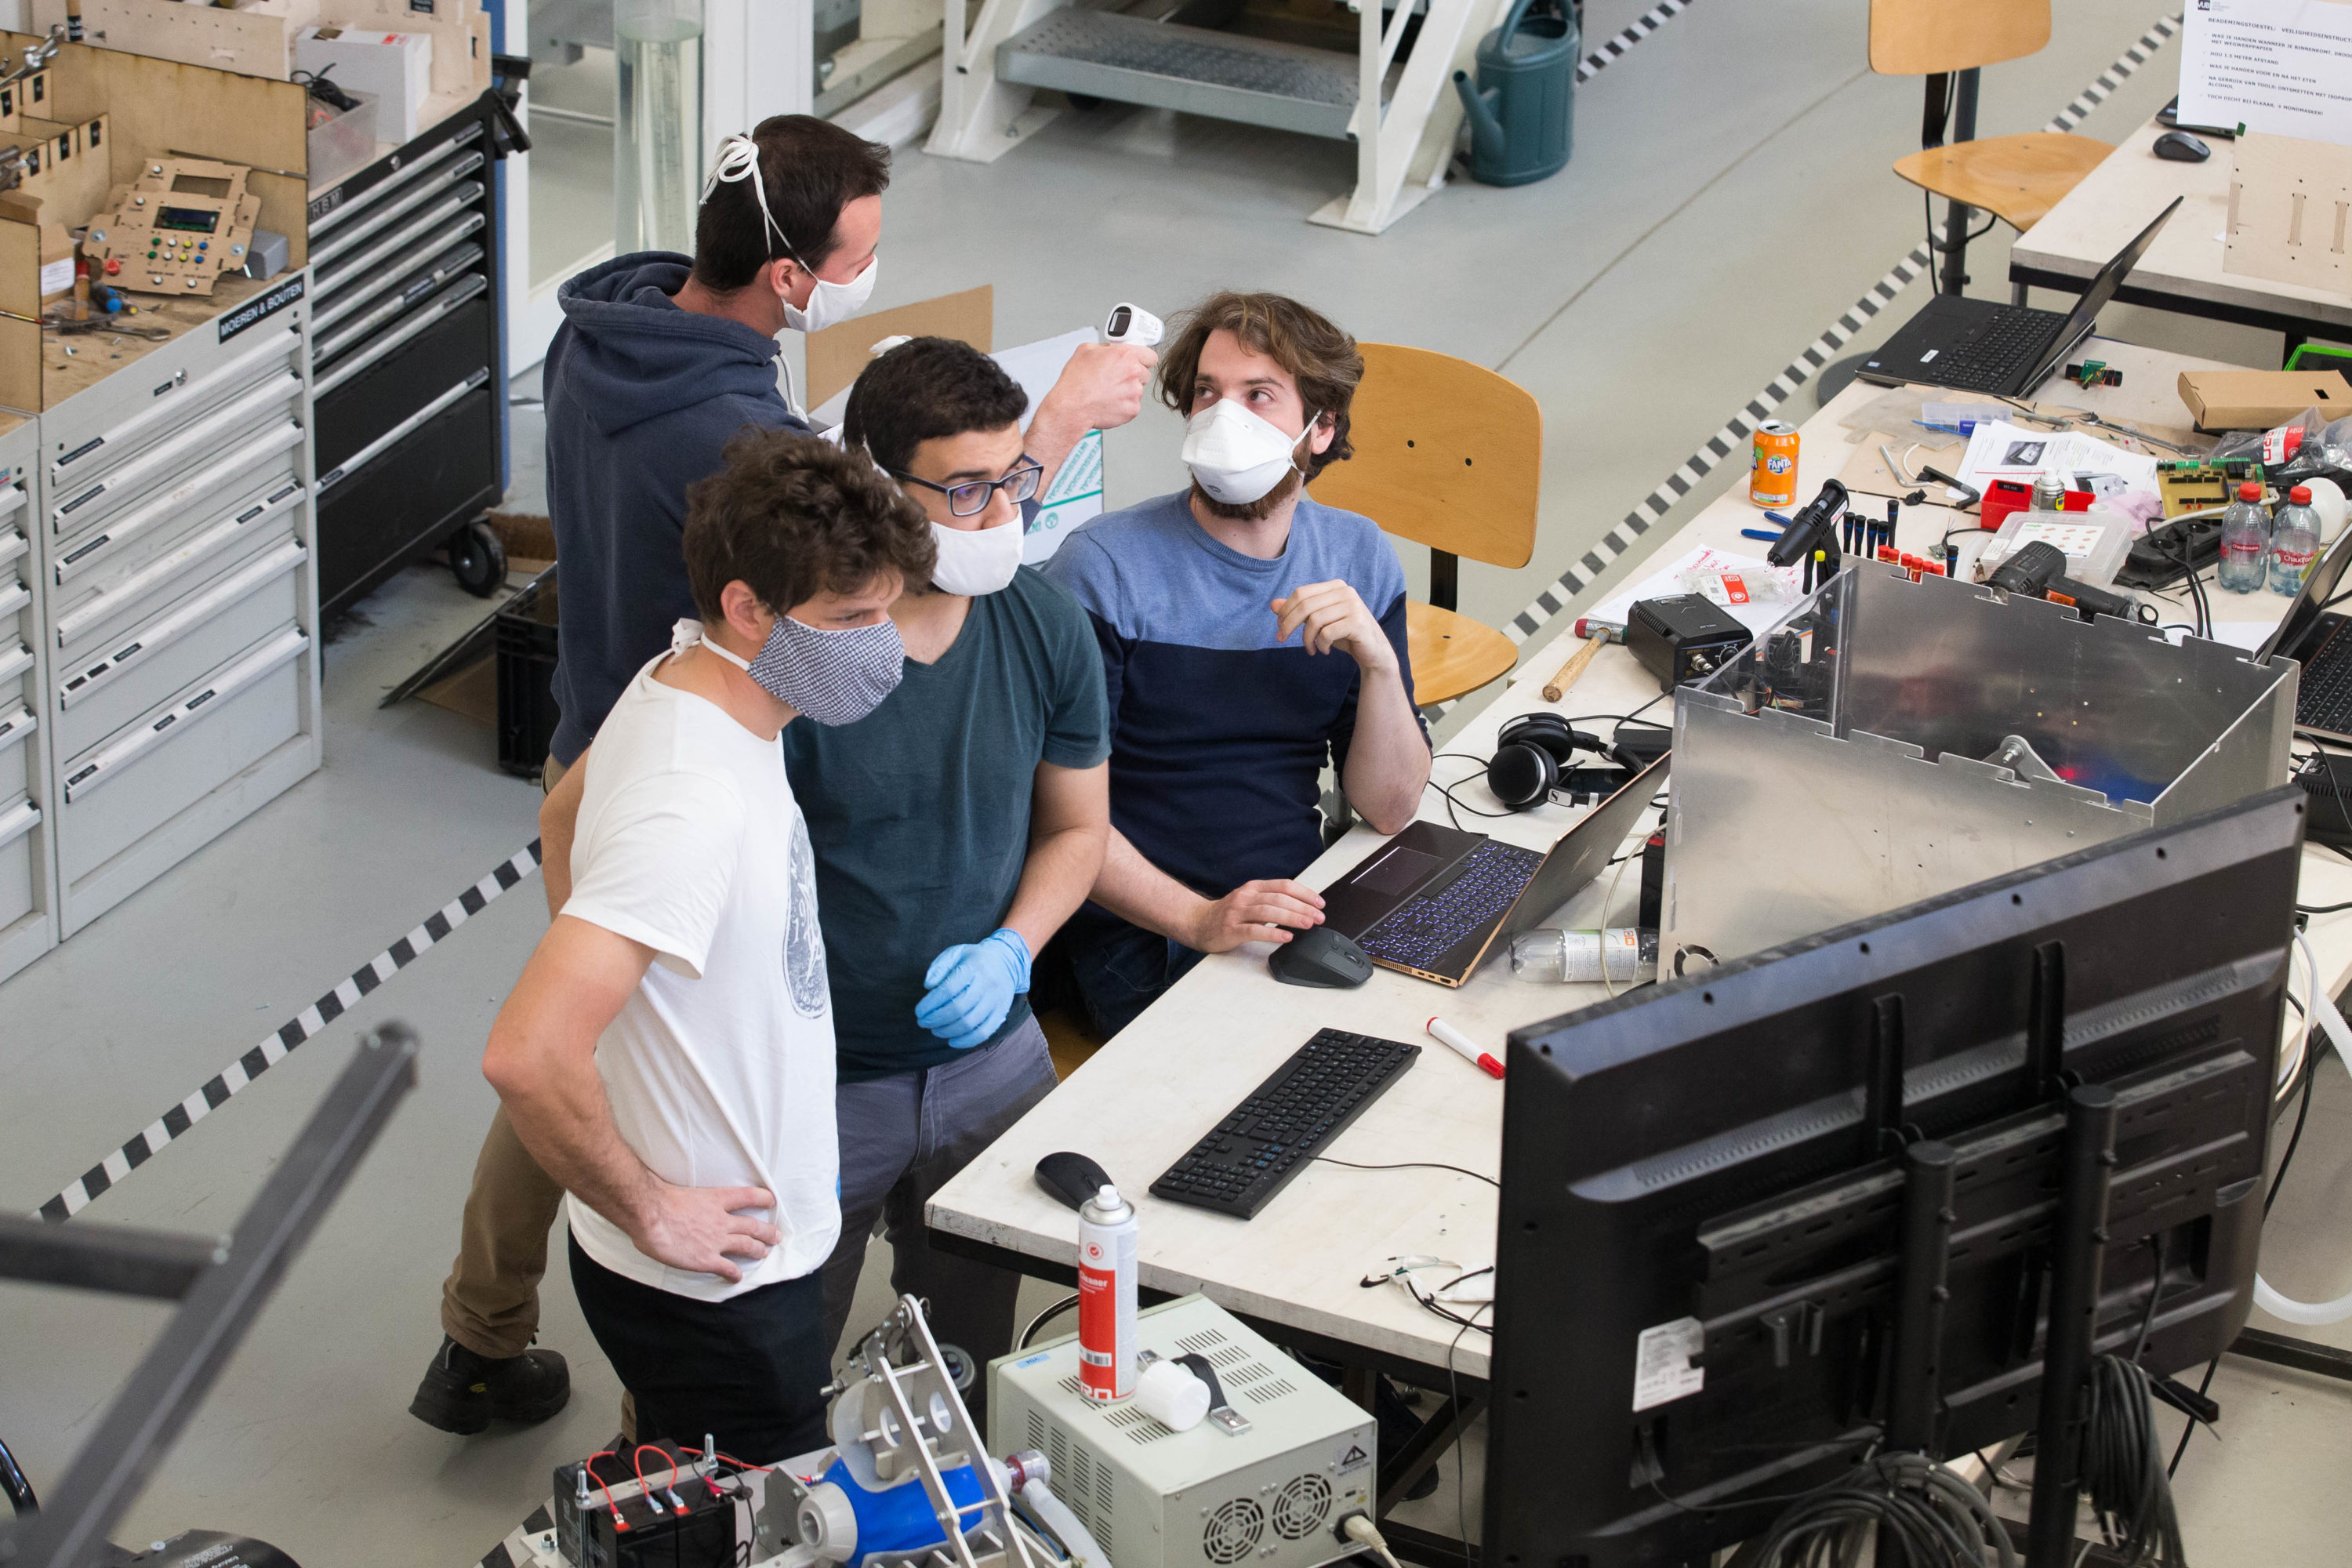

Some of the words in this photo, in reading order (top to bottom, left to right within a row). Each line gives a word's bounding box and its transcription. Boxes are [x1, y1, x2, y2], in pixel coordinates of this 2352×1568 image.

[2223, 41, 2273, 52] WEGWERPPAPIER
[2258, 39, 2285, 48] WANNEER
[220, 306, 259, 337] MOEREN
[259, 302, 267, 314] &
[267, 281, 303, 310] BOUTEN
[1766, 458, 1791, 470] FANTA
